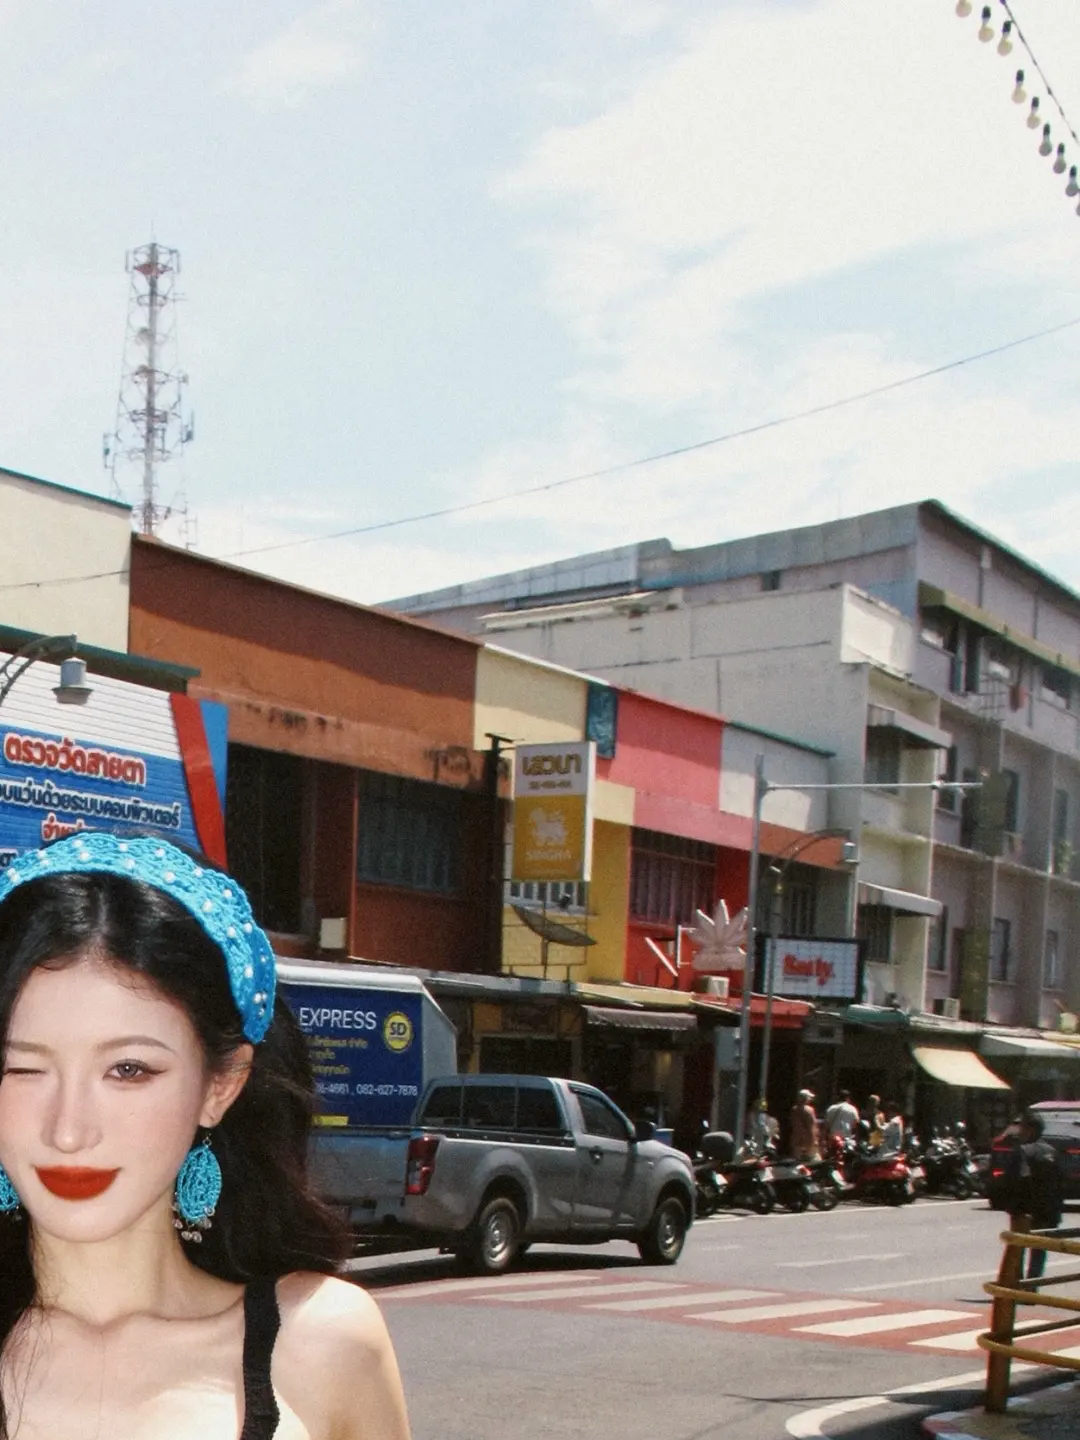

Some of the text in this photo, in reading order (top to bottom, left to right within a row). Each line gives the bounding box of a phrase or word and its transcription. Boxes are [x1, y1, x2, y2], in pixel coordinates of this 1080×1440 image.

[4, 733, 146, 786] ตรวจวัดสายตา
[299, 1007, 377, 1030] EXPRESS
